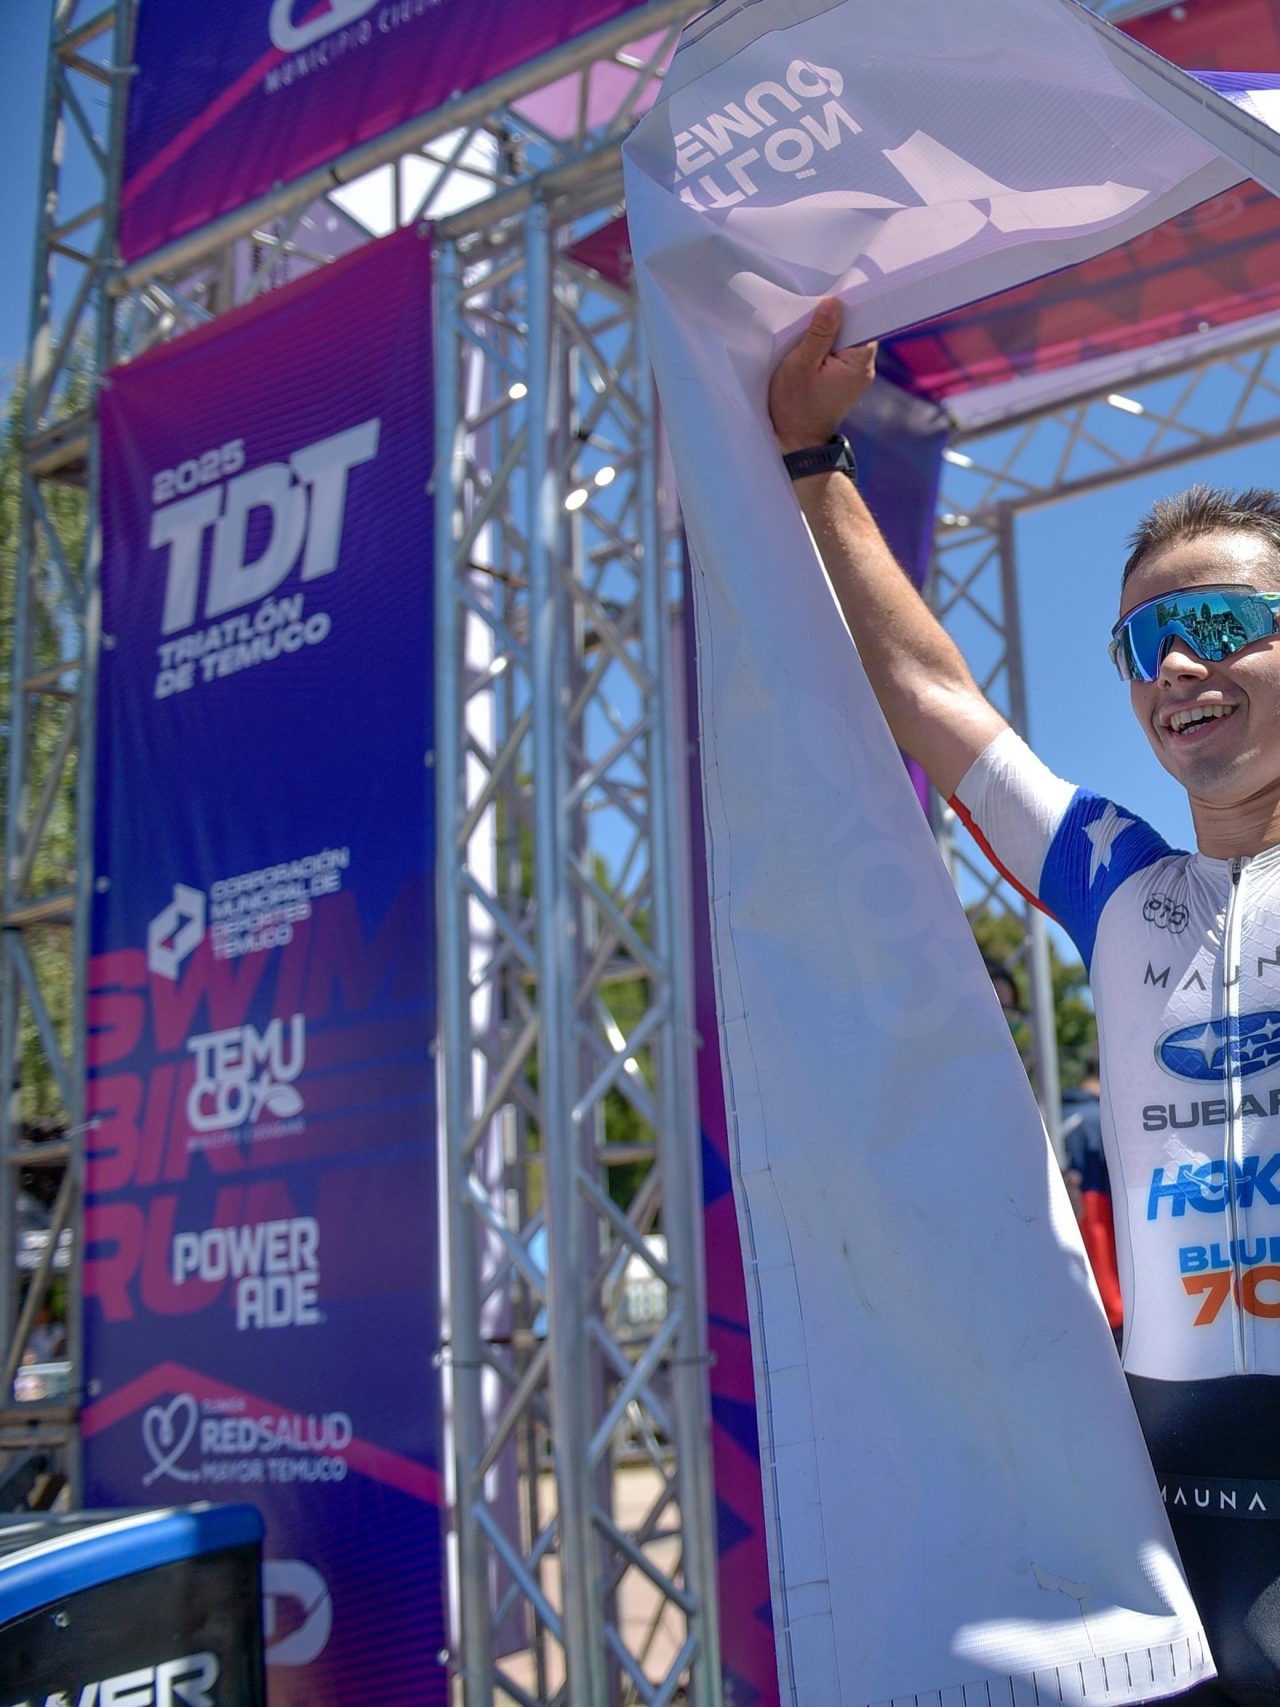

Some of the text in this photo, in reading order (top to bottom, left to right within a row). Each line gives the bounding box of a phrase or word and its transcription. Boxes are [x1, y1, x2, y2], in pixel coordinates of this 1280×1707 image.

[152, 438, 246, 504] 2025
[149, 417, 381, 636] TDT
[154, 612, 332, 700] DE TEMUCO
[157, 592, 305, 669] TRIATLÓN
[310, 868, 342, 898] DE
[212, 922, 294, 960] TEMUCO
[186, 1013, 305, 1084] TEMU
[172, 1216, 320, 1285] POWER
[236, 1272, 321, 1331] ADE
[201, 1411, 352, 1454] REDSALUD
[200, 1454, 348, 1484] MAYOR TEMUCO
